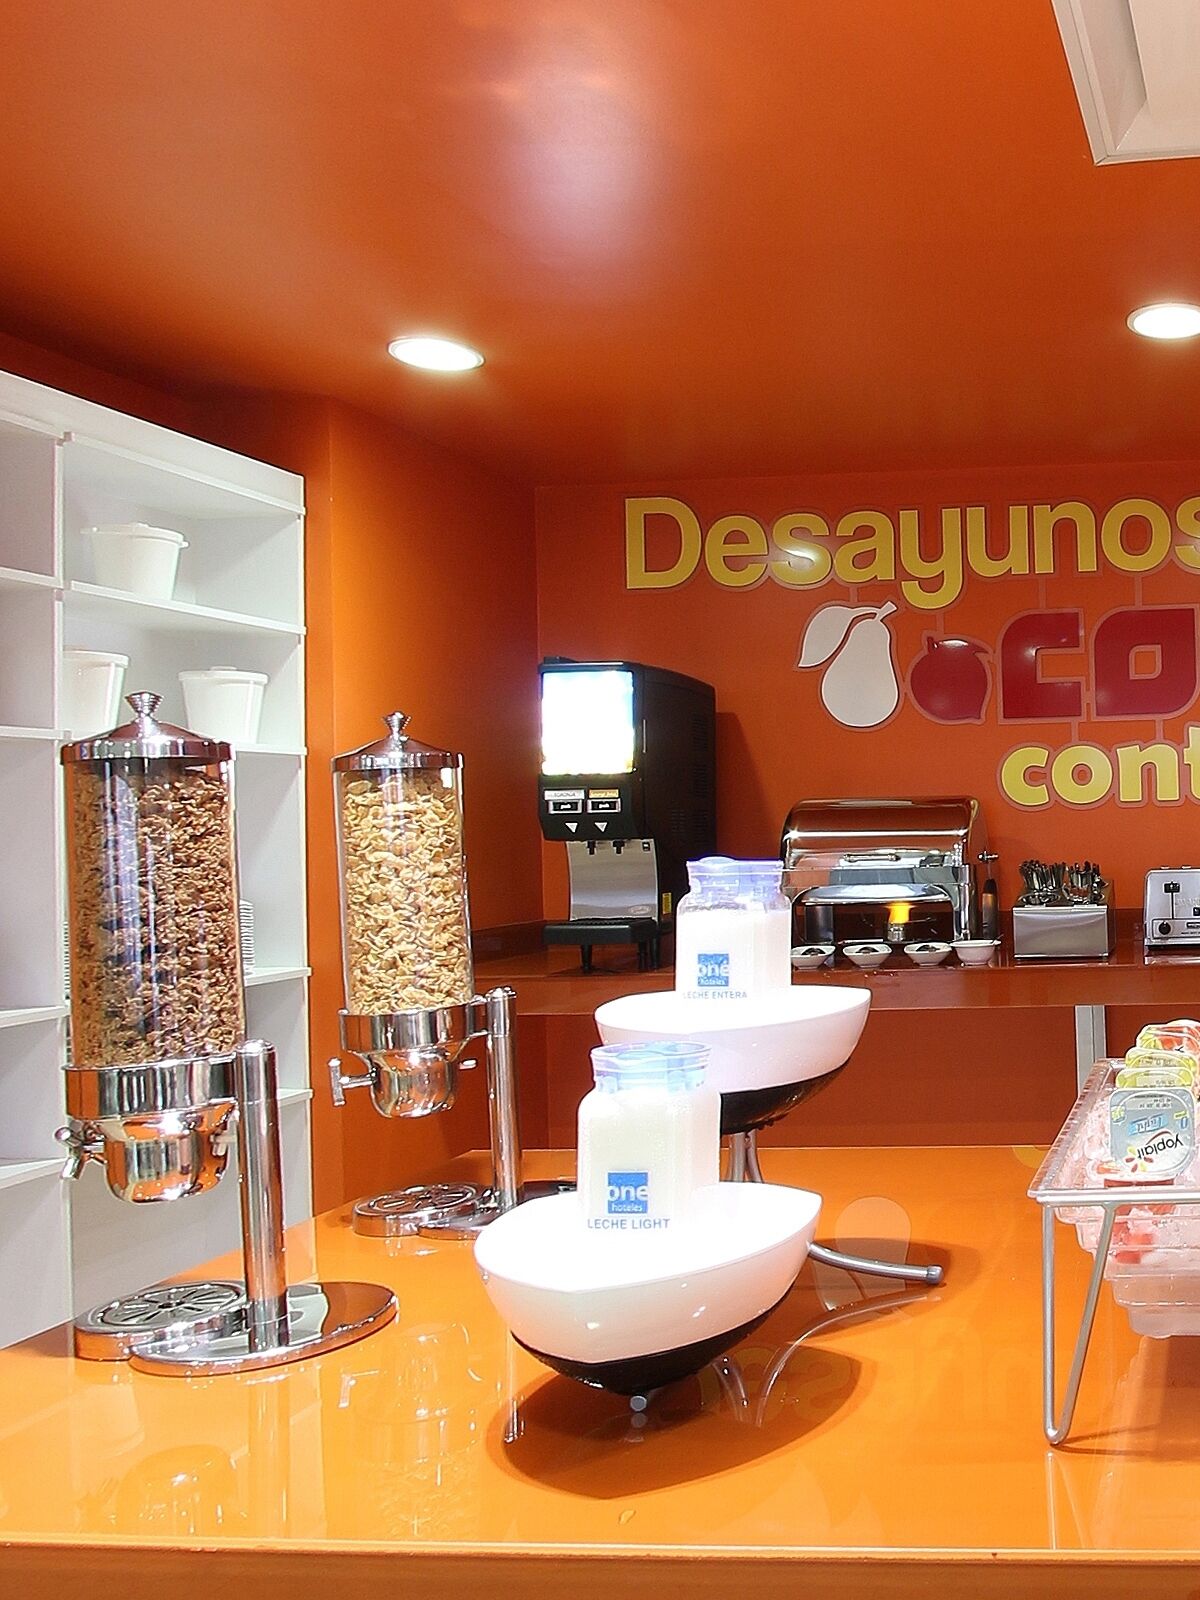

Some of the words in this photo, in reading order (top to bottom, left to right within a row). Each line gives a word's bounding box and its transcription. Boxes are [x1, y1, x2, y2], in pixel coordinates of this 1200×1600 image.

[698, 963, 729, 978] one
[712, 991, 748, 1000] ENTERA
[607, 1185, 648, 1201] one
[587, 1218, 628, 1230] LECHE
[631, 1218, 671, 1230] LIGHT
